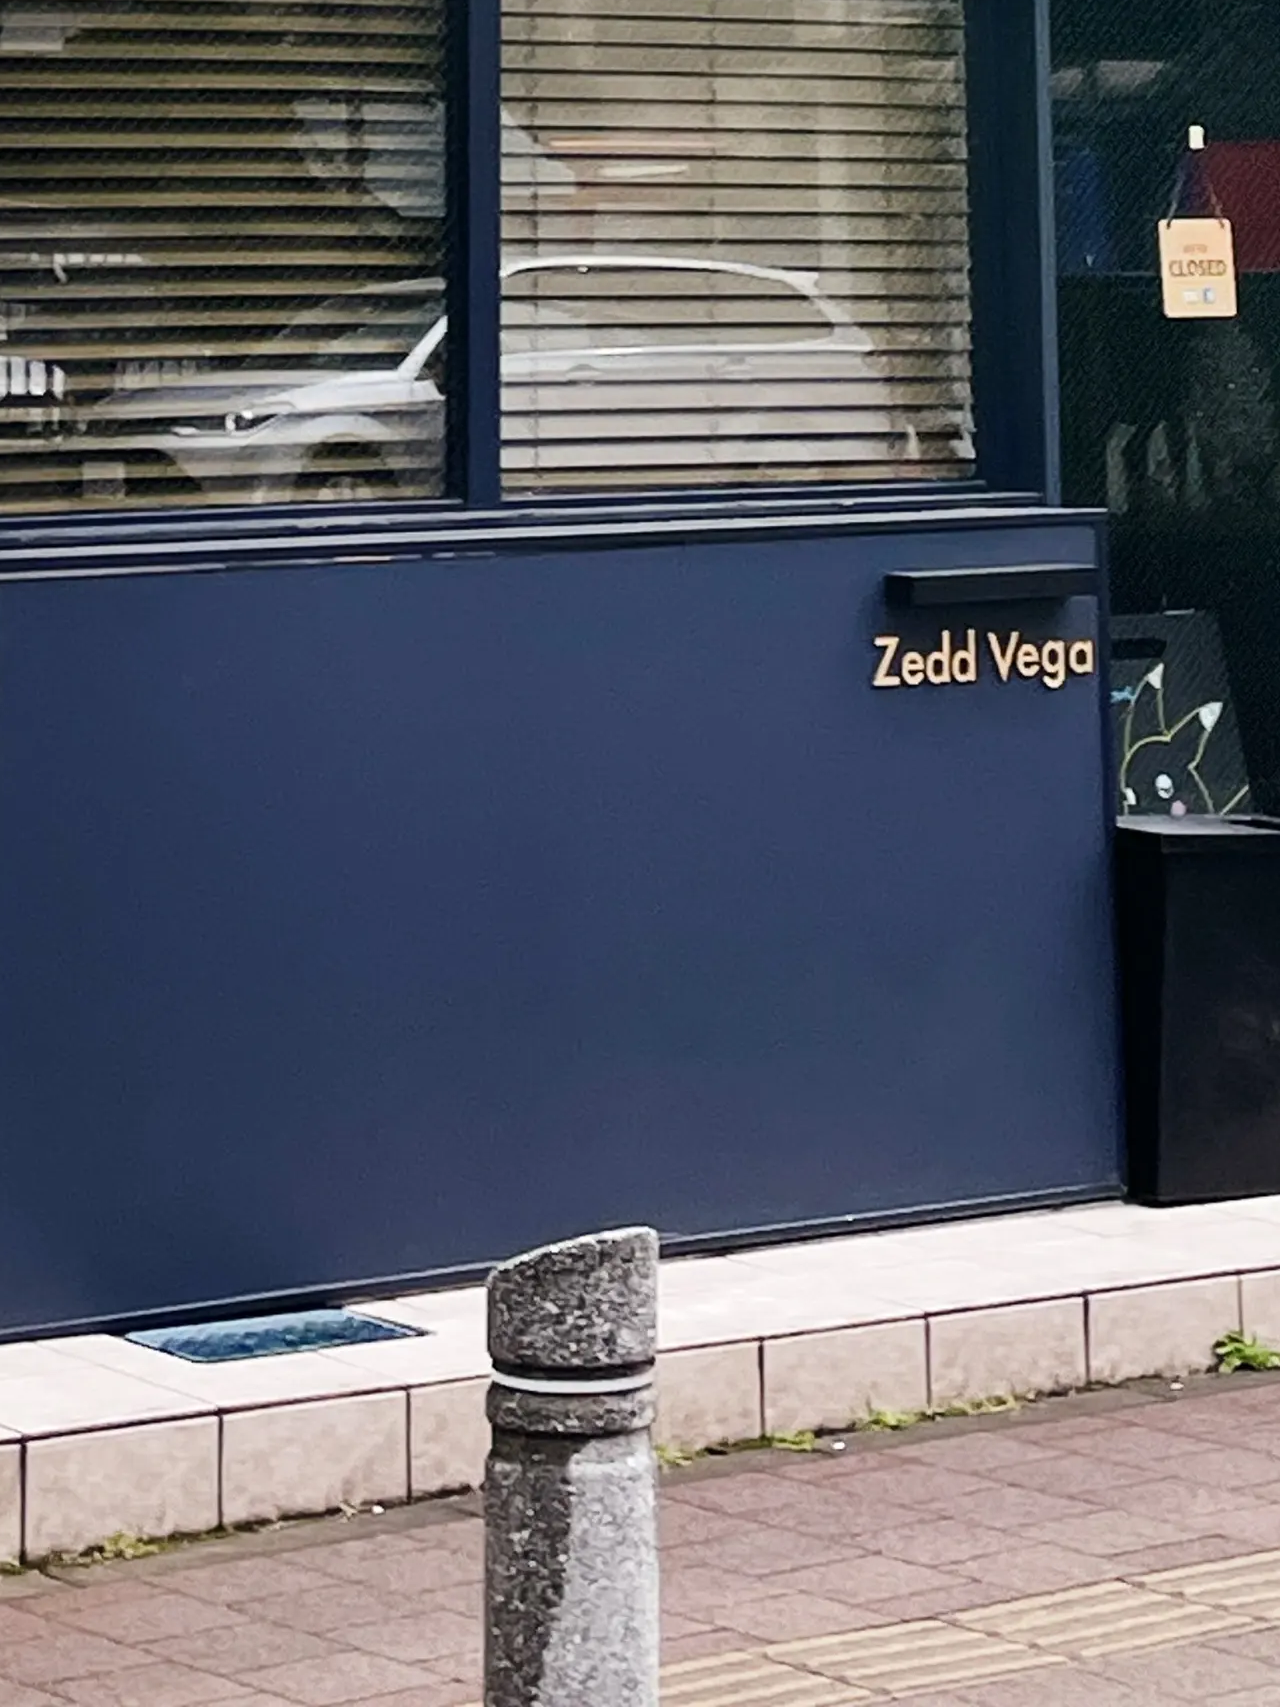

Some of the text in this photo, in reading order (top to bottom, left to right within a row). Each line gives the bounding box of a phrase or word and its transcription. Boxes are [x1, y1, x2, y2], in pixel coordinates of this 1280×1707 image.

[1169, 259, 1227, 277] CLOSED
[872, 628, 1094, 689] Zedd Vega
